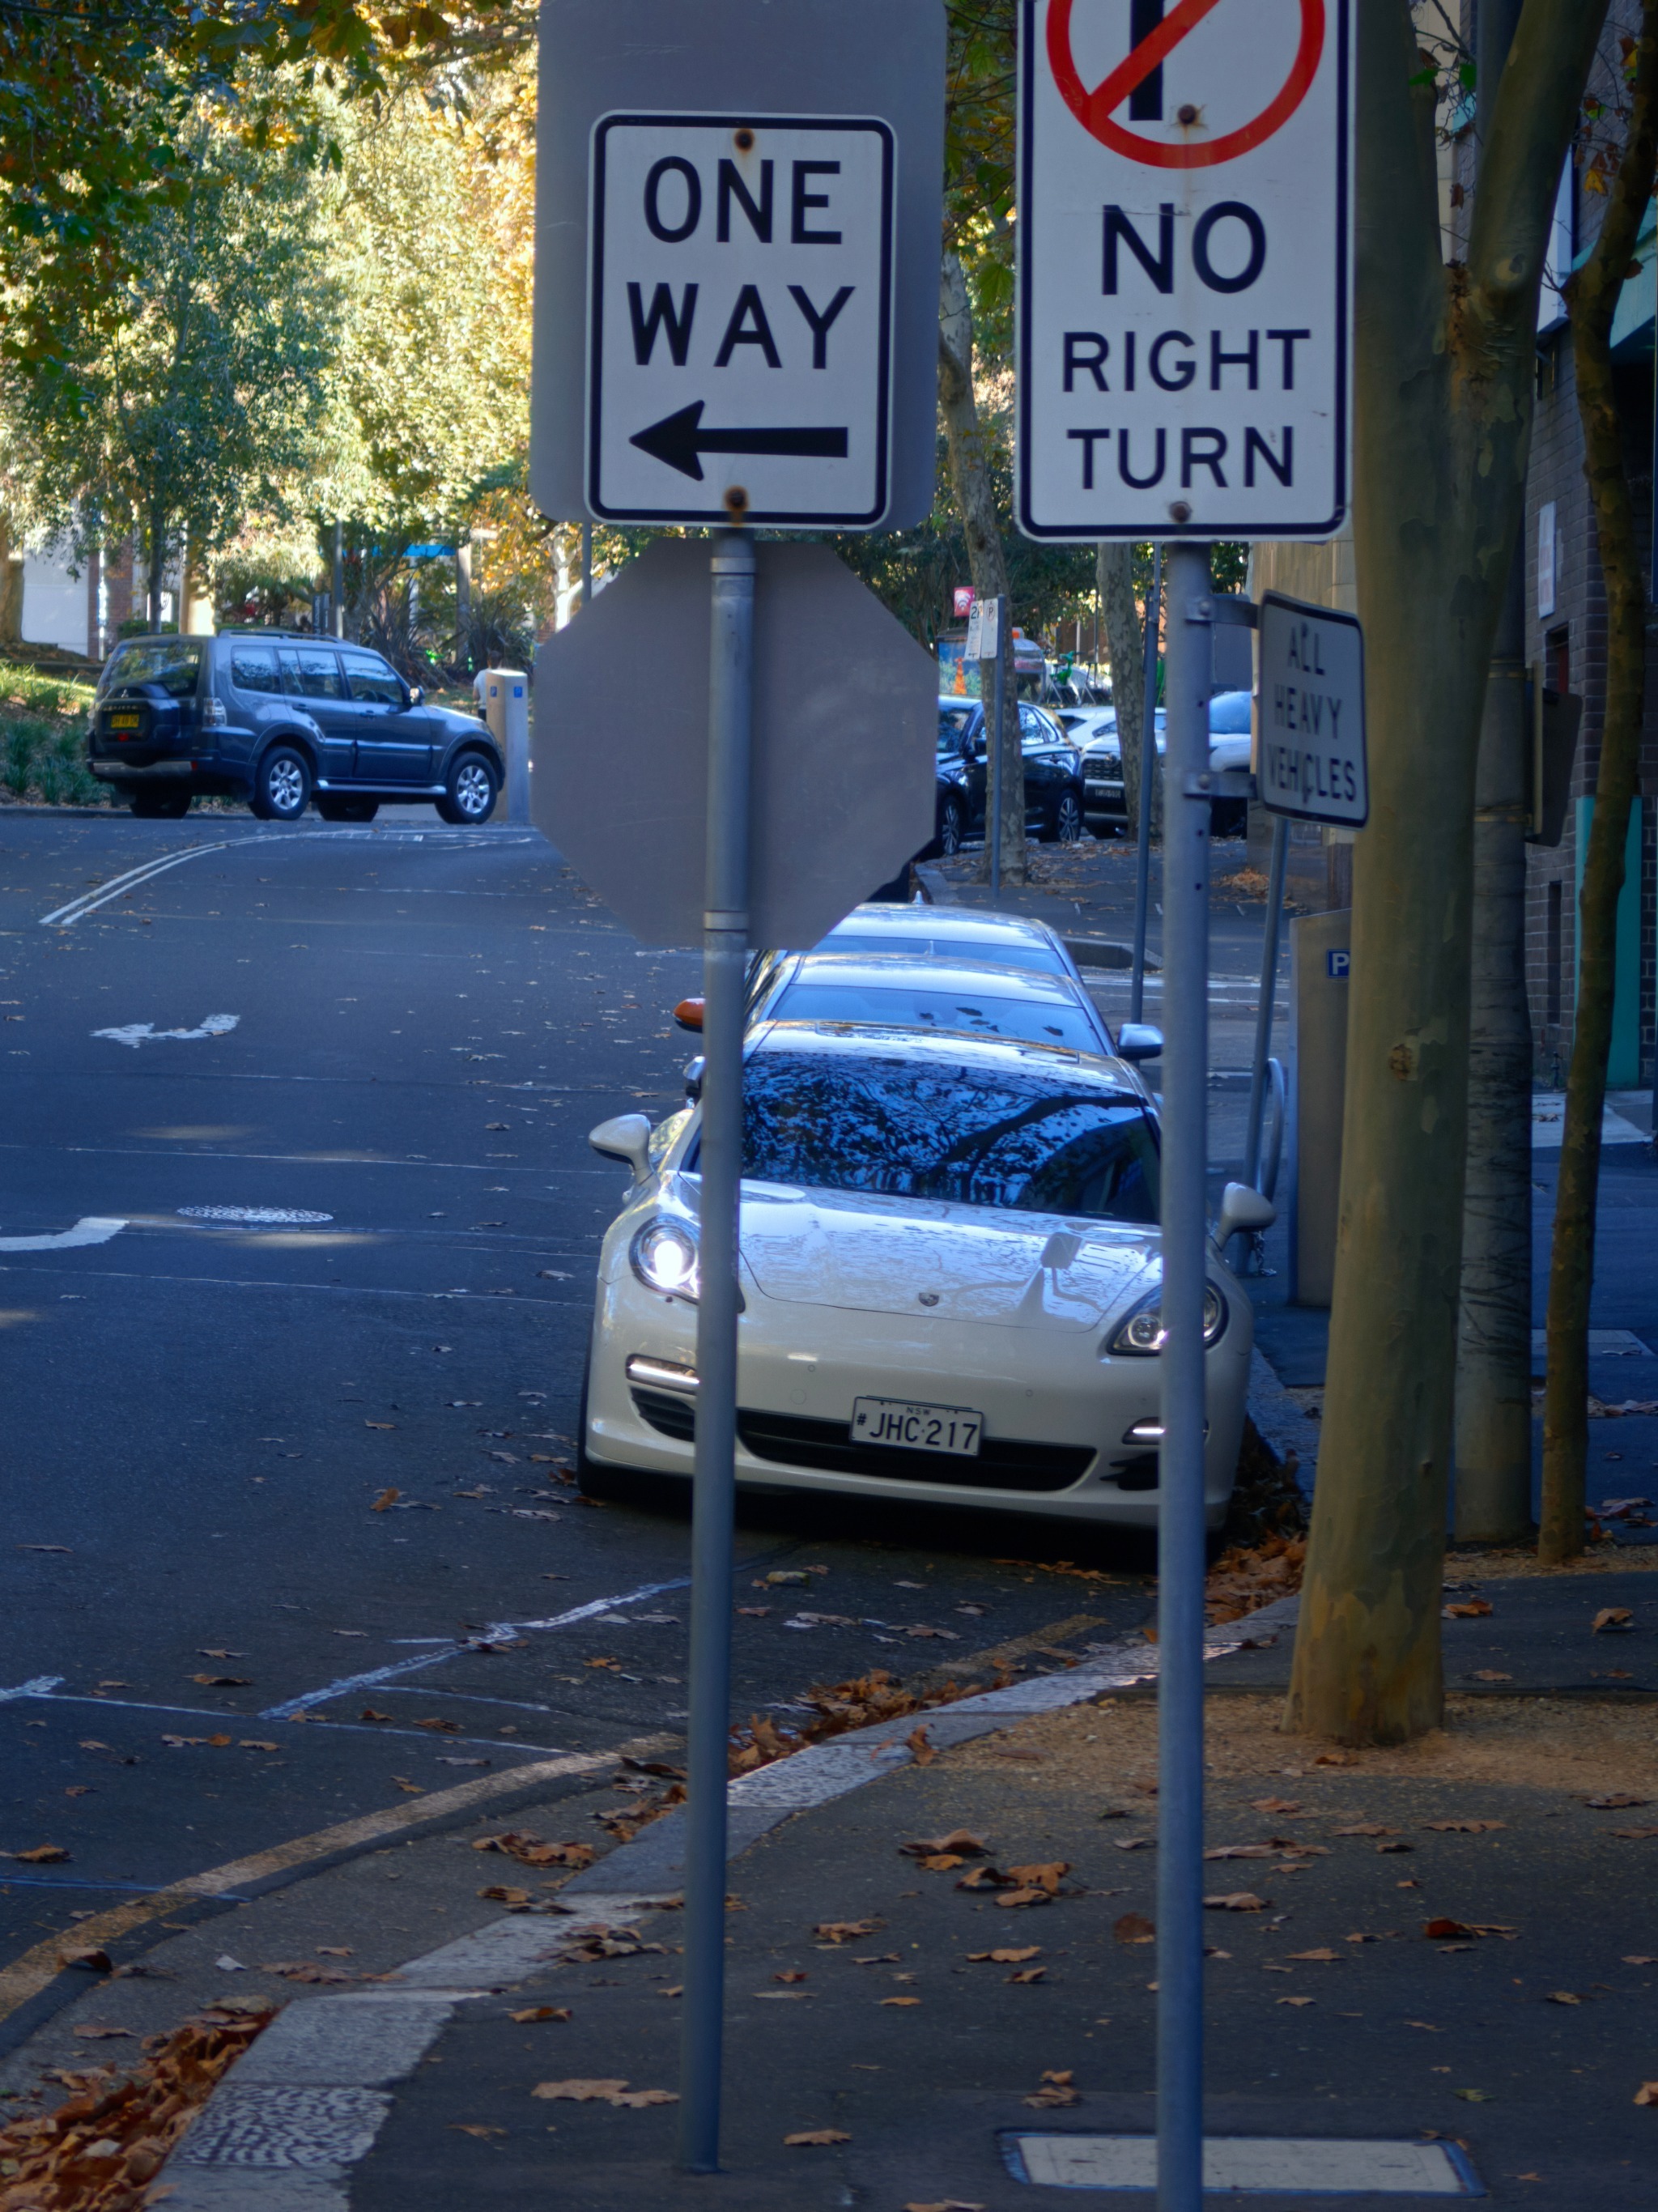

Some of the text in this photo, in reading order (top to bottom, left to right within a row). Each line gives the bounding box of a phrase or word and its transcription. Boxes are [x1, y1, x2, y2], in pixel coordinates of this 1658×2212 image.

[643, 155, 842, 244] ONE
[1102, 200, 1266, 295] NO
[627, 282, 857, 369] WAY
[1062, 329, 1311, 392] RIGHT
[1066, 426, 1293, 489] TURN
[1287, 625, 1325, 676] ALL
[1273, 684, 1342, 740] HEAVY
[1267, 743, 1357, 802] VEHICLES
[1332, 952, 1350, 976] P
[906, 1406, 930, 1415] NSW
